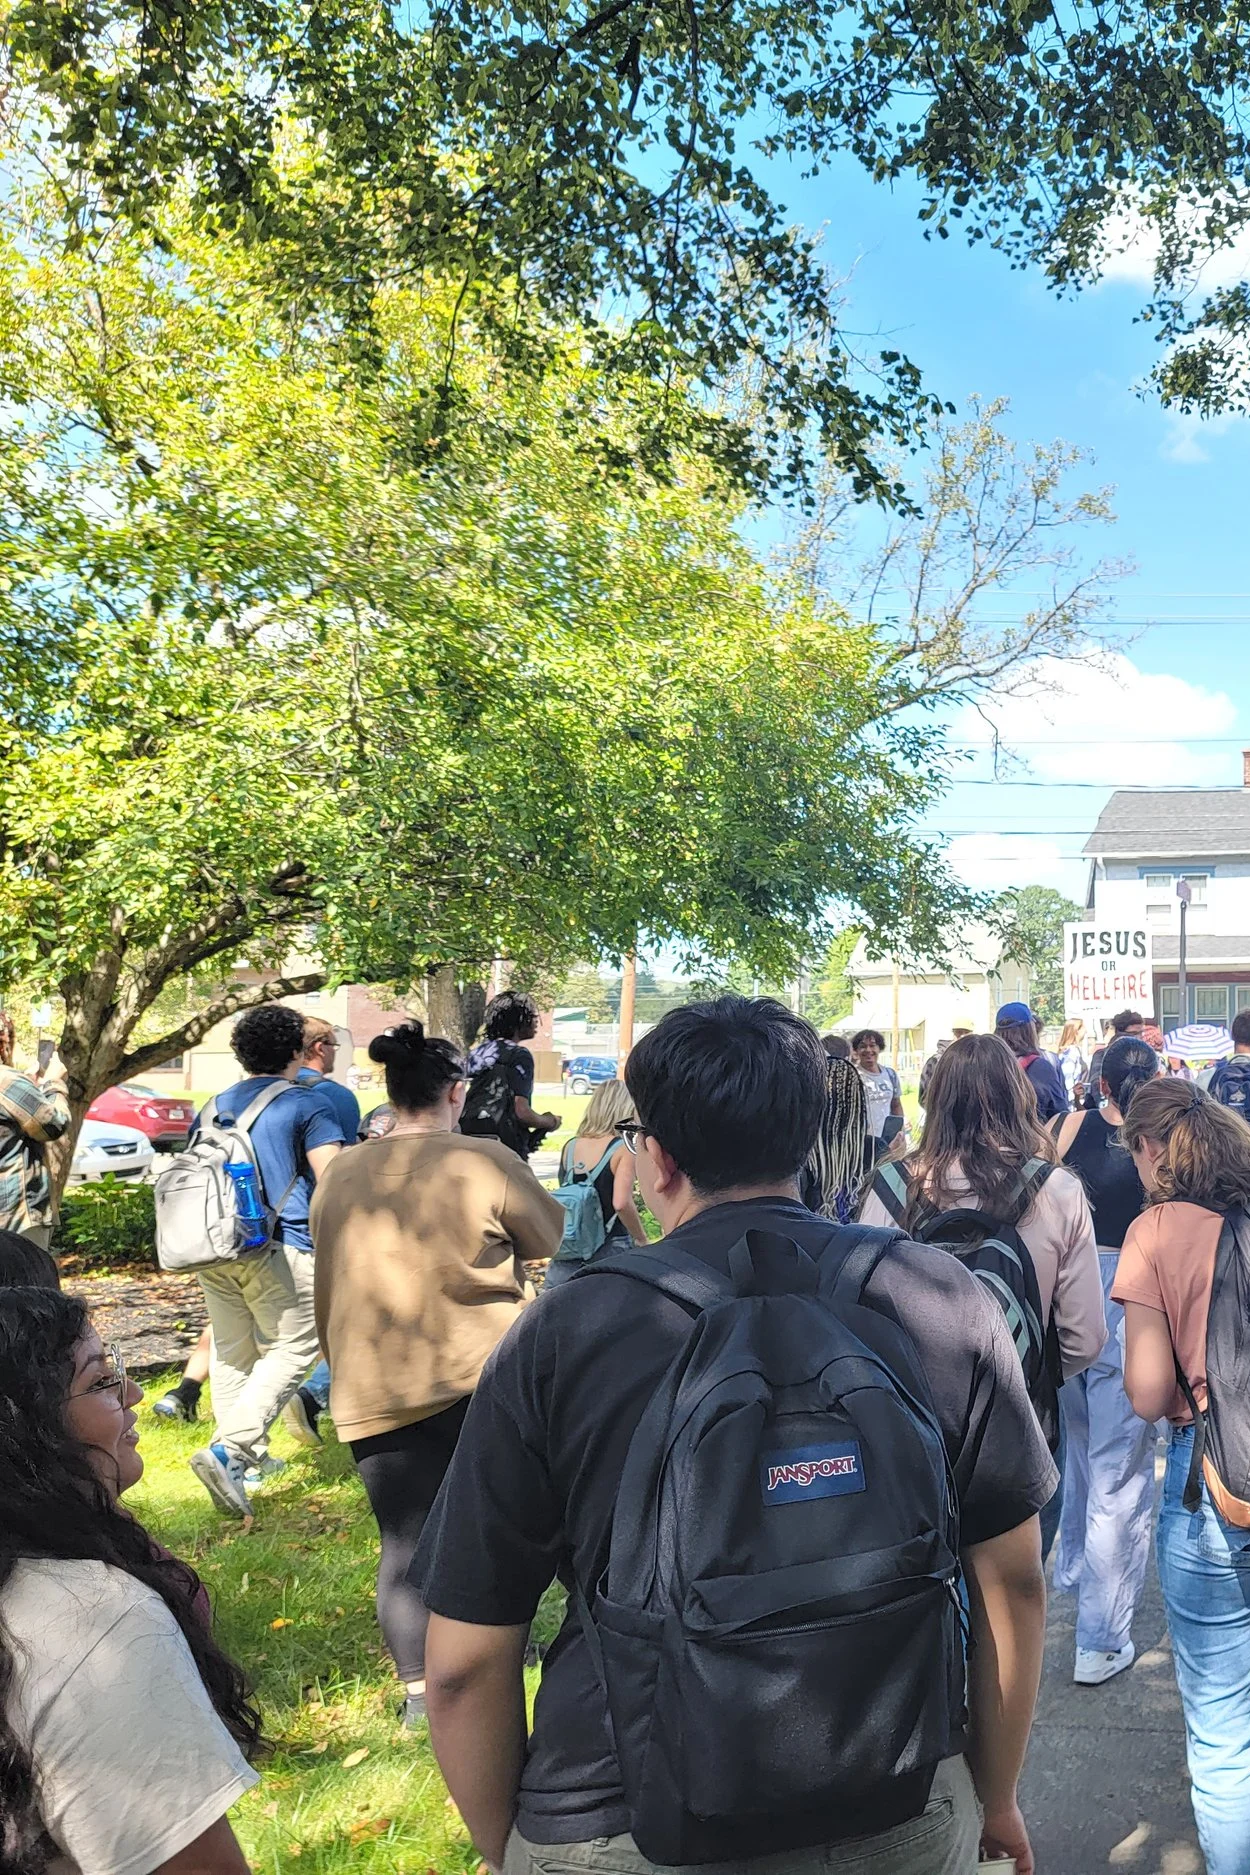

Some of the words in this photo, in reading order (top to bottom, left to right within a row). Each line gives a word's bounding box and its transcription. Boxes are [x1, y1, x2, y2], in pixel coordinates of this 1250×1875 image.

[1070, 931, 1147, 963] JESUS
[1101, 960, 1116, 971] OR
[1070, 971, 1148, 1000] HELLFIRE
[767, 1456, 856, 1490] JANSPORT
